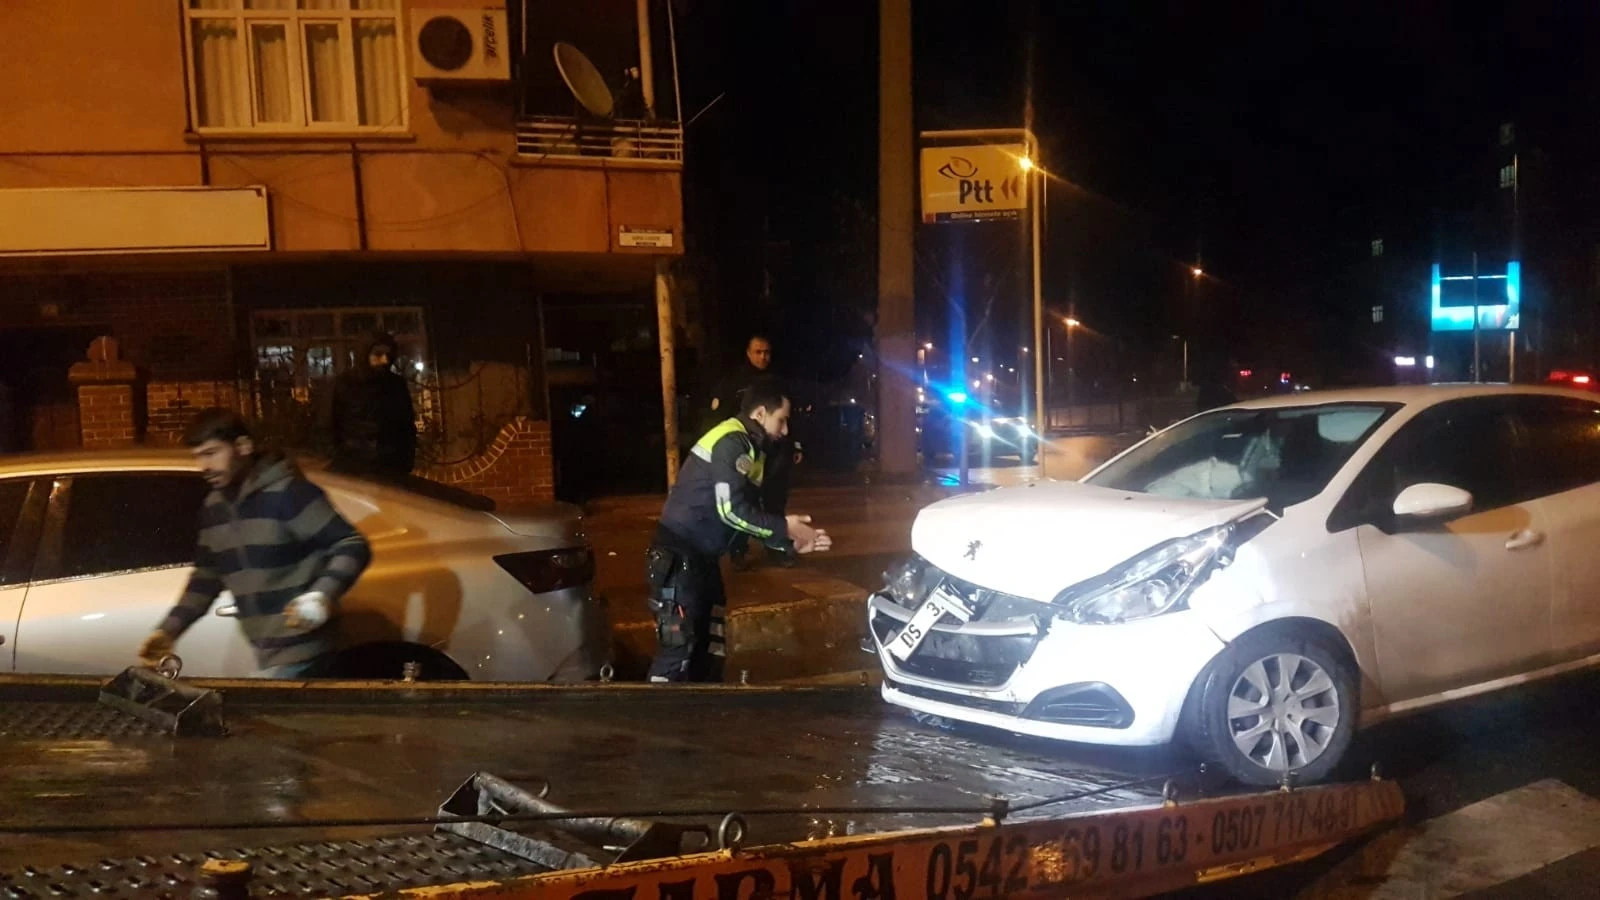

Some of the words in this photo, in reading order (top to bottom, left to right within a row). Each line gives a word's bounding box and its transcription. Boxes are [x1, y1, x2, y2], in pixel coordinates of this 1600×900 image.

[959, 179, 994, 204] Ptt
[926, 601, 945, 617] 3
[926, 833, 1028, 900] 0542
[1031, 825, 1101, 888] 69
[1111, 821, 1144, 873] 81
[1156, 815, 1188, 864] 63
[1212, 805, 1267, 855] 0507
